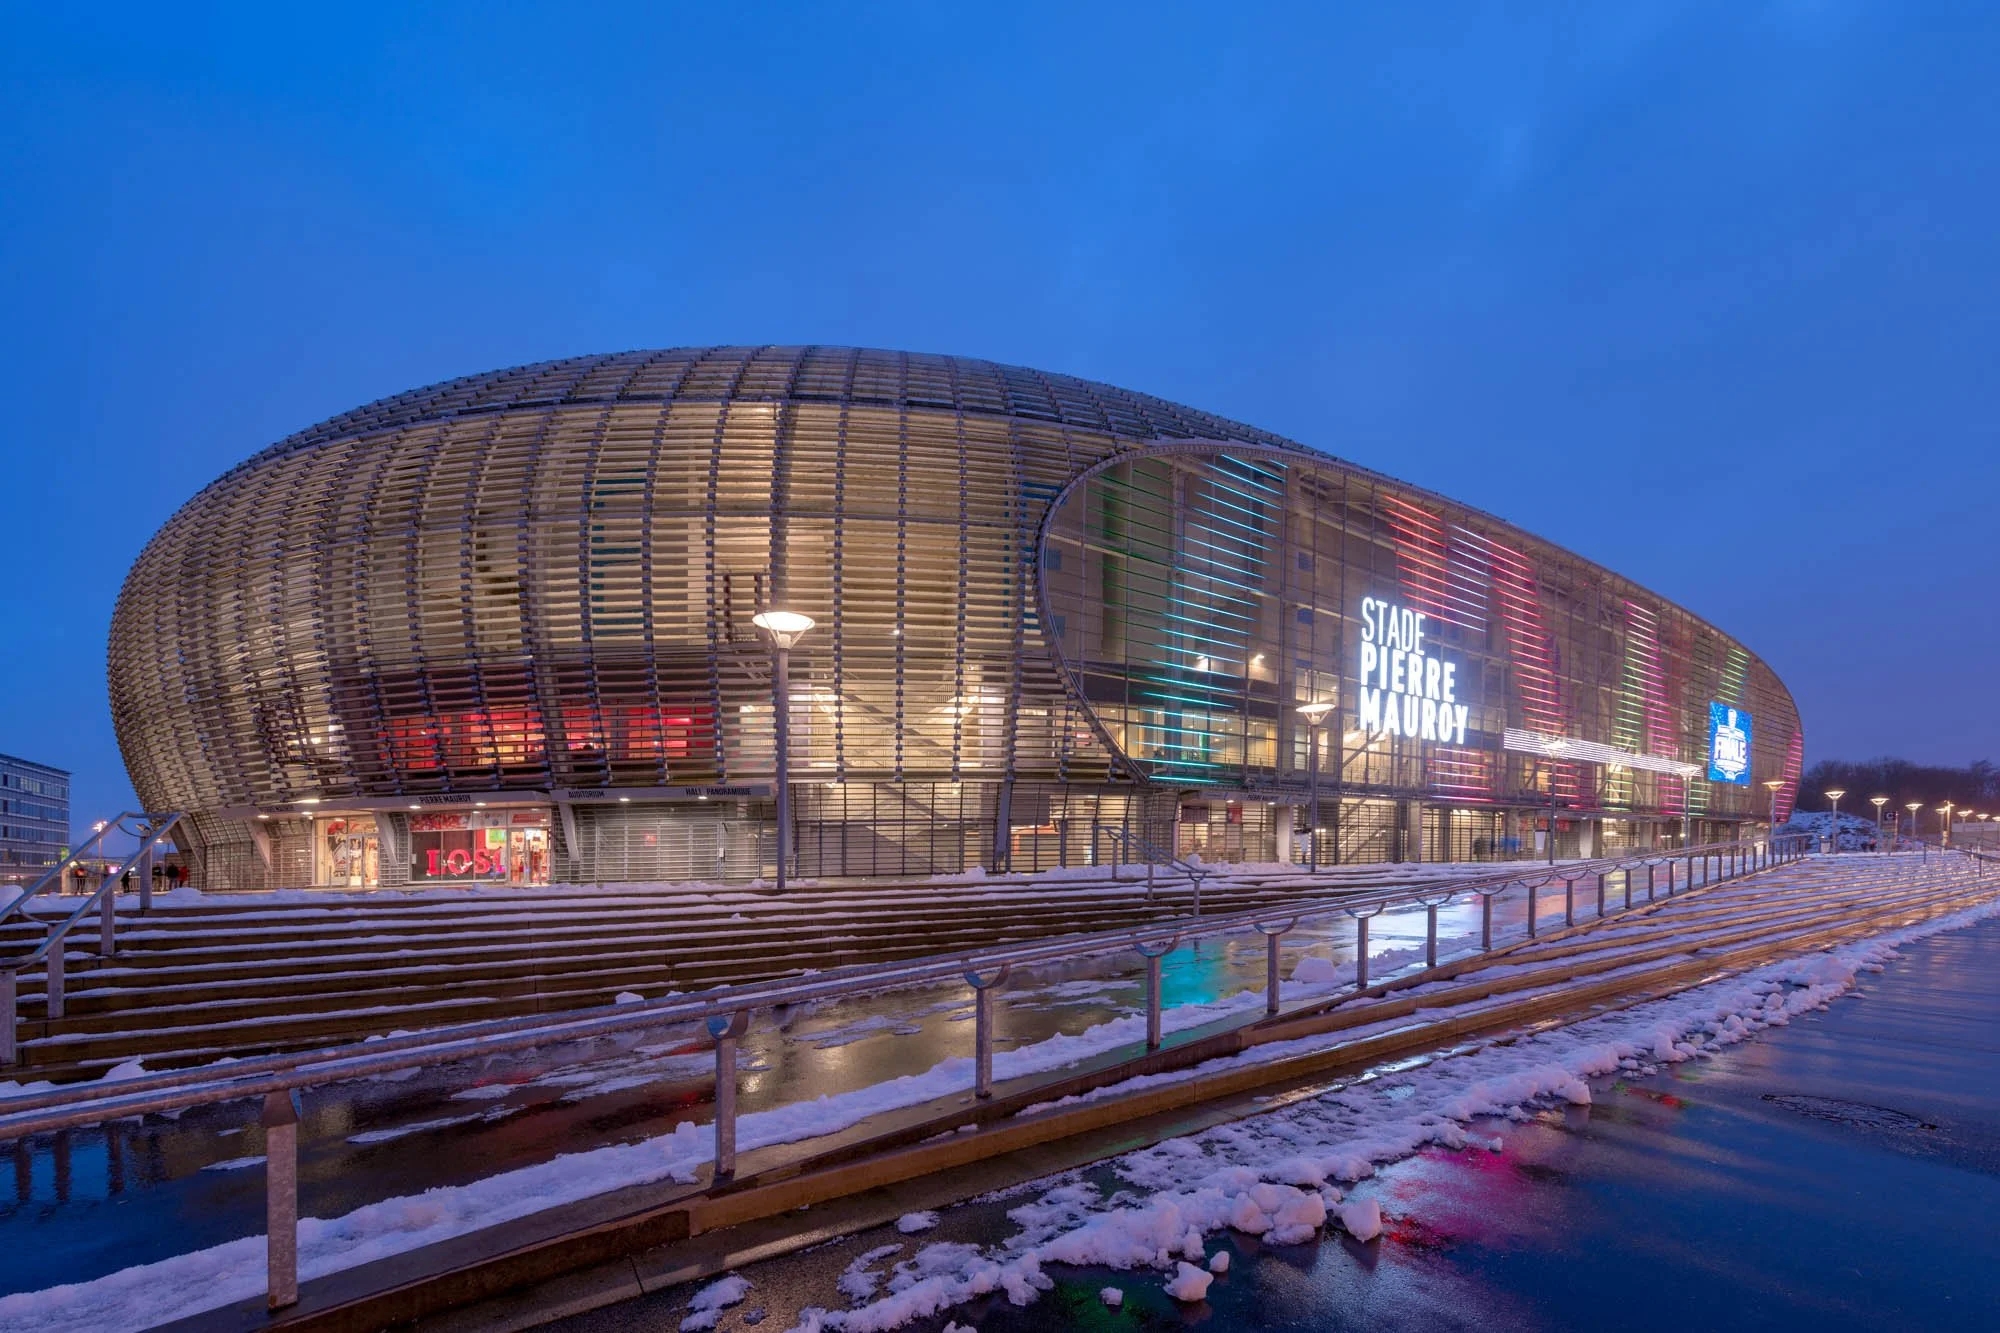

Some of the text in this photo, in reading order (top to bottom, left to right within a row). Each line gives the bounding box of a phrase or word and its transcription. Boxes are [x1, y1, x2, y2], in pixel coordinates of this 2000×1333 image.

[1361, 596, 1426, 656] STADE
[1360, 641, 1456, 703] PIERRE
[1359, 686, 1469, 744] MAUROY
[419, 794, 471, 805] PIERRE MAUROY
[568, 790, 605, 799] AUDITORIUM
[685, 787, 702, 796] HALL
